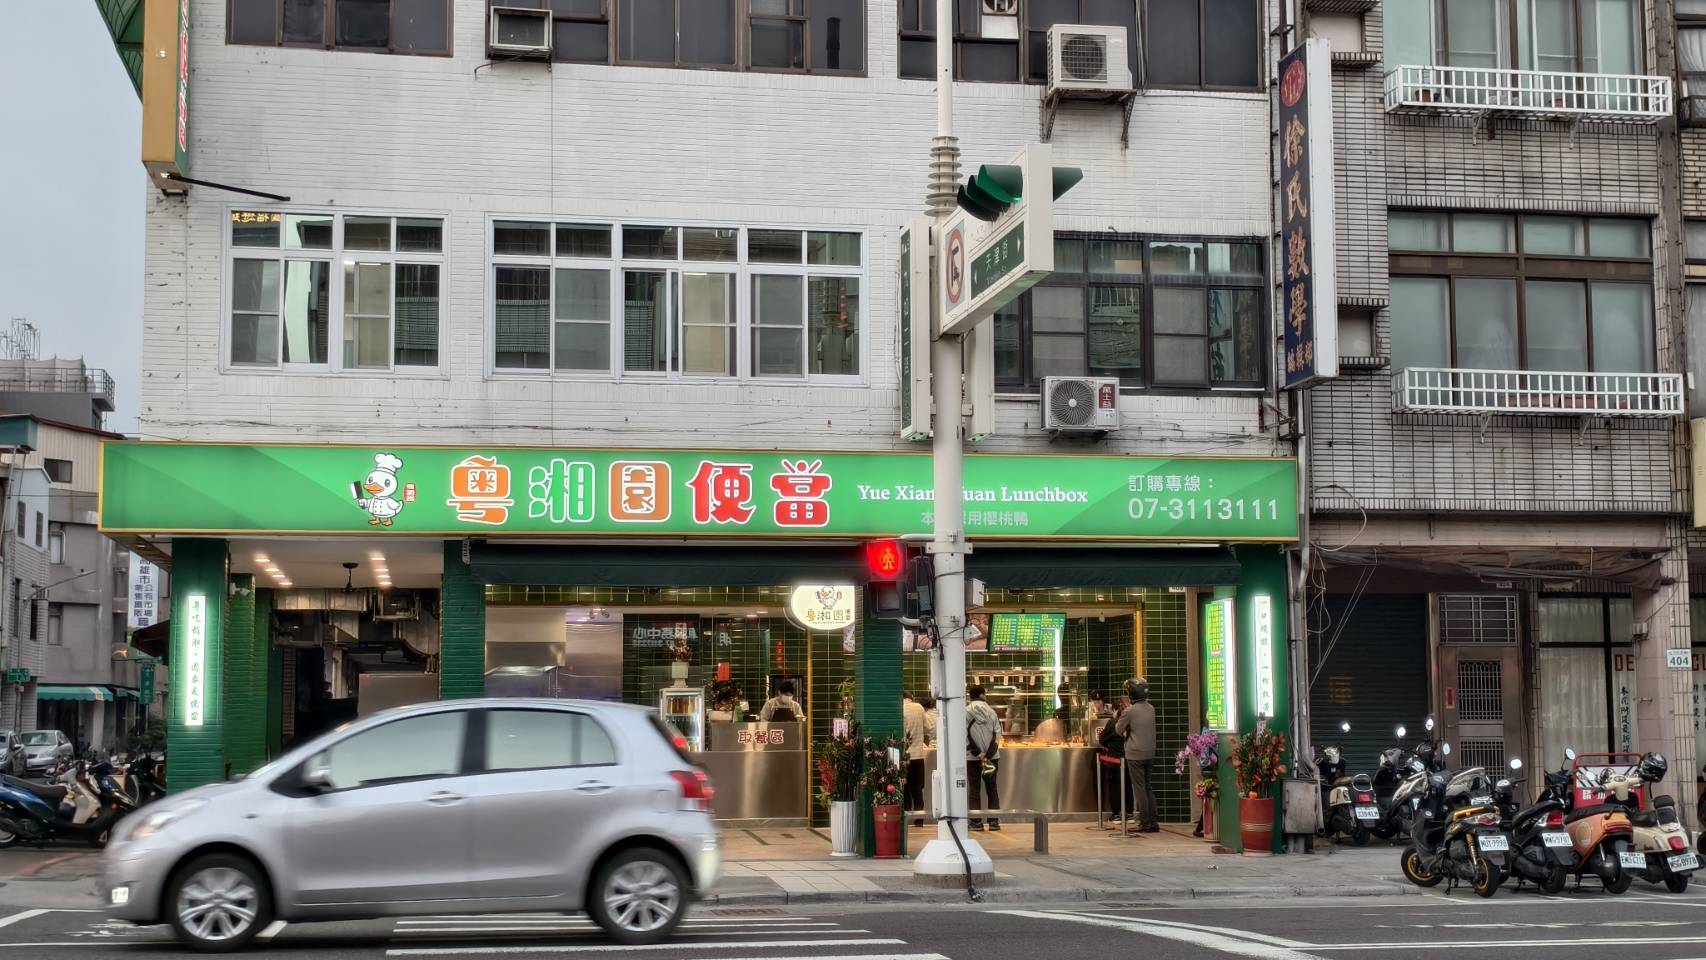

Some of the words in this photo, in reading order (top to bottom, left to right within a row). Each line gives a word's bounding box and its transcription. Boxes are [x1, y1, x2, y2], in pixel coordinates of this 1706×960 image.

[1283, 113, 1310, 337] 徐氏數學
[447, 454, 832, 528] 粵湘園便當
[857, 485, 890, 501] Yue
[895, 485, 935, 501] Xian
[962, 487, 996, 502] uan
[1001, 486, 1089, 503] Lunchbox
[1128, 498, 1278, 520] 07-3113111
[1670, 655, 1689, 666] 404
[737, 729, 785, 745] 取餐區
